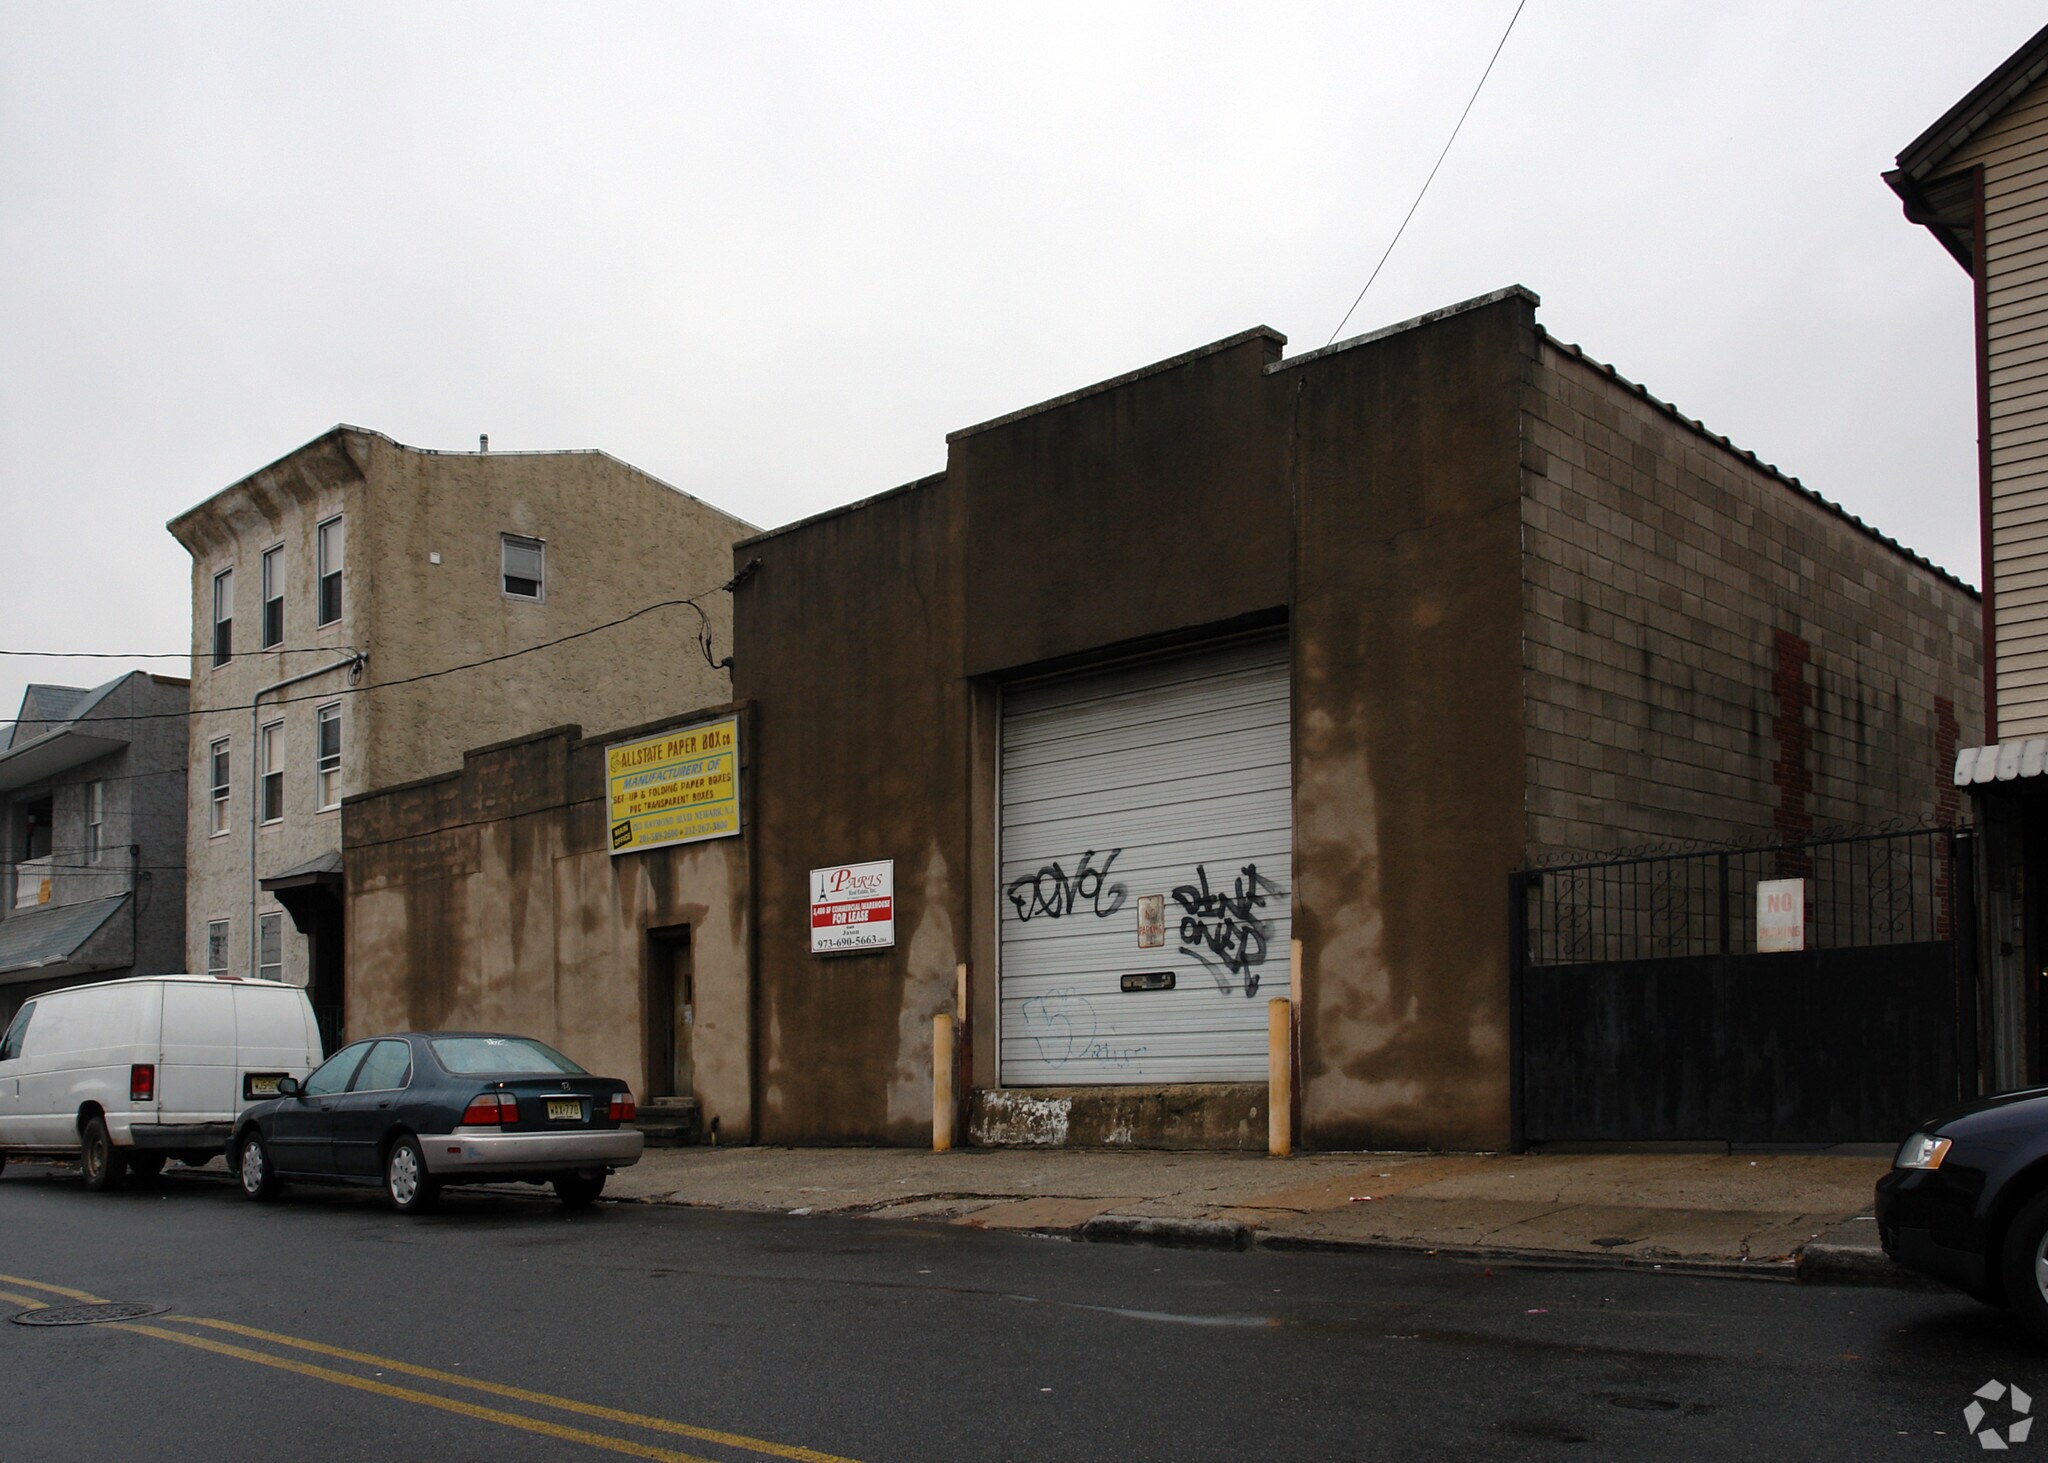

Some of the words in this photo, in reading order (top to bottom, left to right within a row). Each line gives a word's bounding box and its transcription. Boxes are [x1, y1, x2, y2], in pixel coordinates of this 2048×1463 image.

[621, 743, 663, 768] ALLSTATE
[667, 736, 697, 758] PAPER
[702, 730, 721, 750] BOX
[623, 762, 703, 789] MANUFACTURERS
[707, 758, 721, 772] OF
[649, 783, 678, 798] FOLDING
[681, 777, 705, 791] PAPER
[708, 772, 731, 786] BOXES
[629, 803, 641, 814] PVC
[644, 794, 689, 810] TRANSPARENT
[692, 789, 714, 801] BOXES
[614, 824, 629, 837] MAIN
[615, 833, 631, 846] OFFICE
[1767, 892, 1793, 913] NO
[832, 912, 847, 925] FOR
[848, 910, 869, 923] LEASE
[817, 935, 877, 948] 973-690-5663
